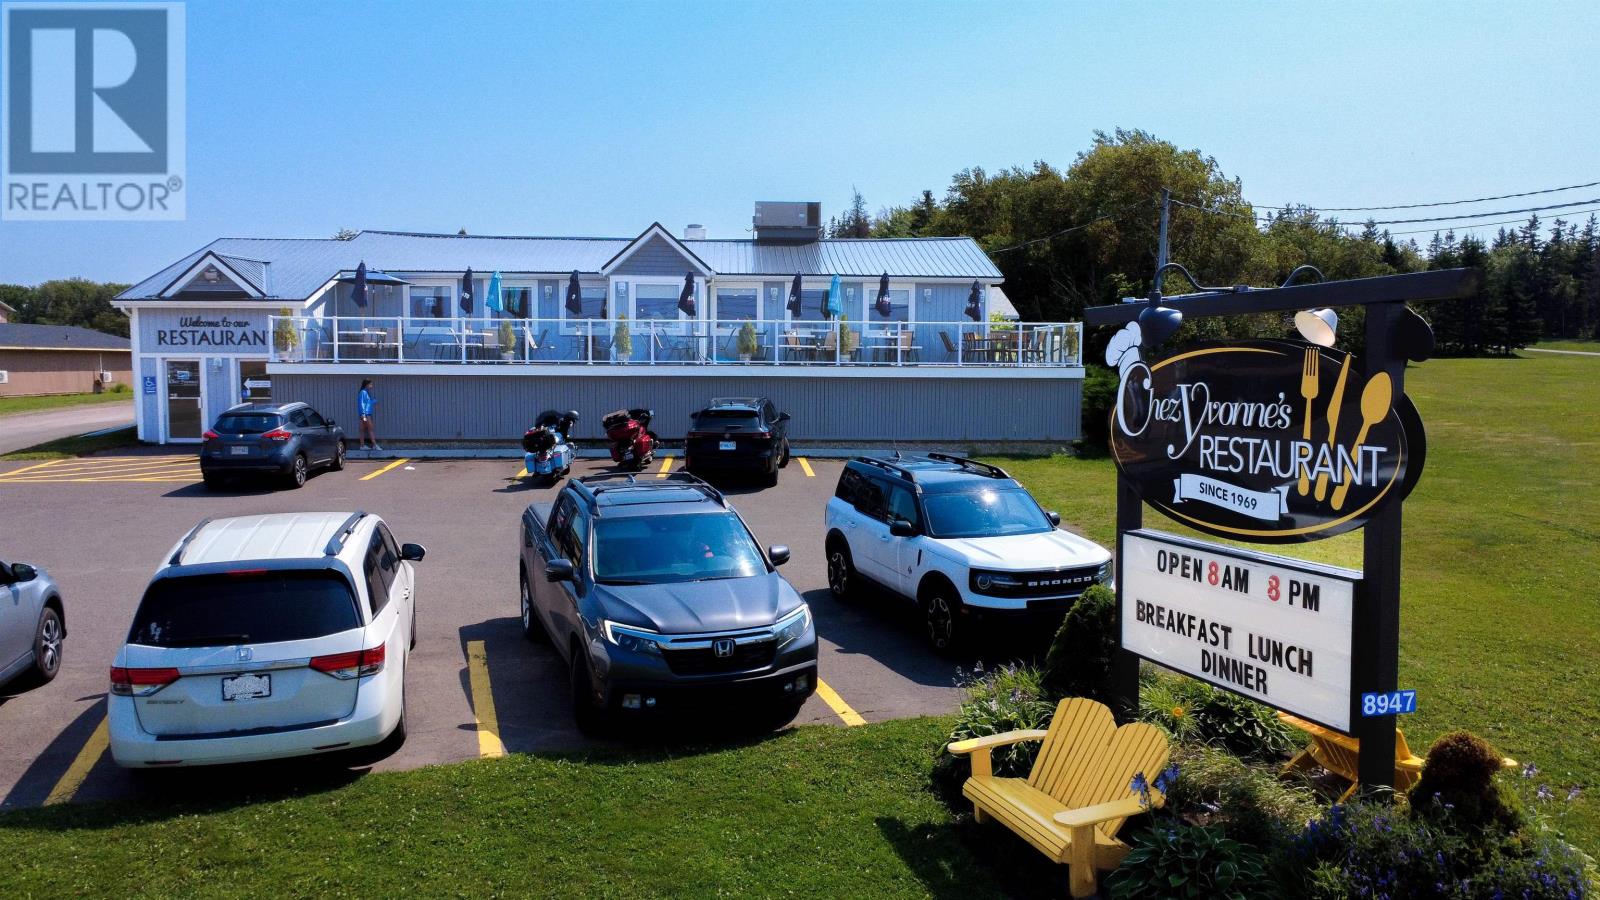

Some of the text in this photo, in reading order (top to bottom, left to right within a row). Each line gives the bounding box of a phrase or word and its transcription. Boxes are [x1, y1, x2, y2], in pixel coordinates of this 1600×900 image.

[180, 315, 250, 328] Welcome to our
[1117, 363, 1292, 459] Chez Yvonne's
[1200, 434, 1388, 488] RESTAURANT
[1199, 481, 1258, 511] SINCE 1969
[1156, 549, 1202, 582] OPEN
[1267, 574, 1281, 602] 8
[1288, 579, 1320, 613] PM
[1135, 599, 1314, 678] BREAKFAST LUNCH
[1200, 649, 1268, 695] DINNER
[1363, 691, 1415, 715] 8947
